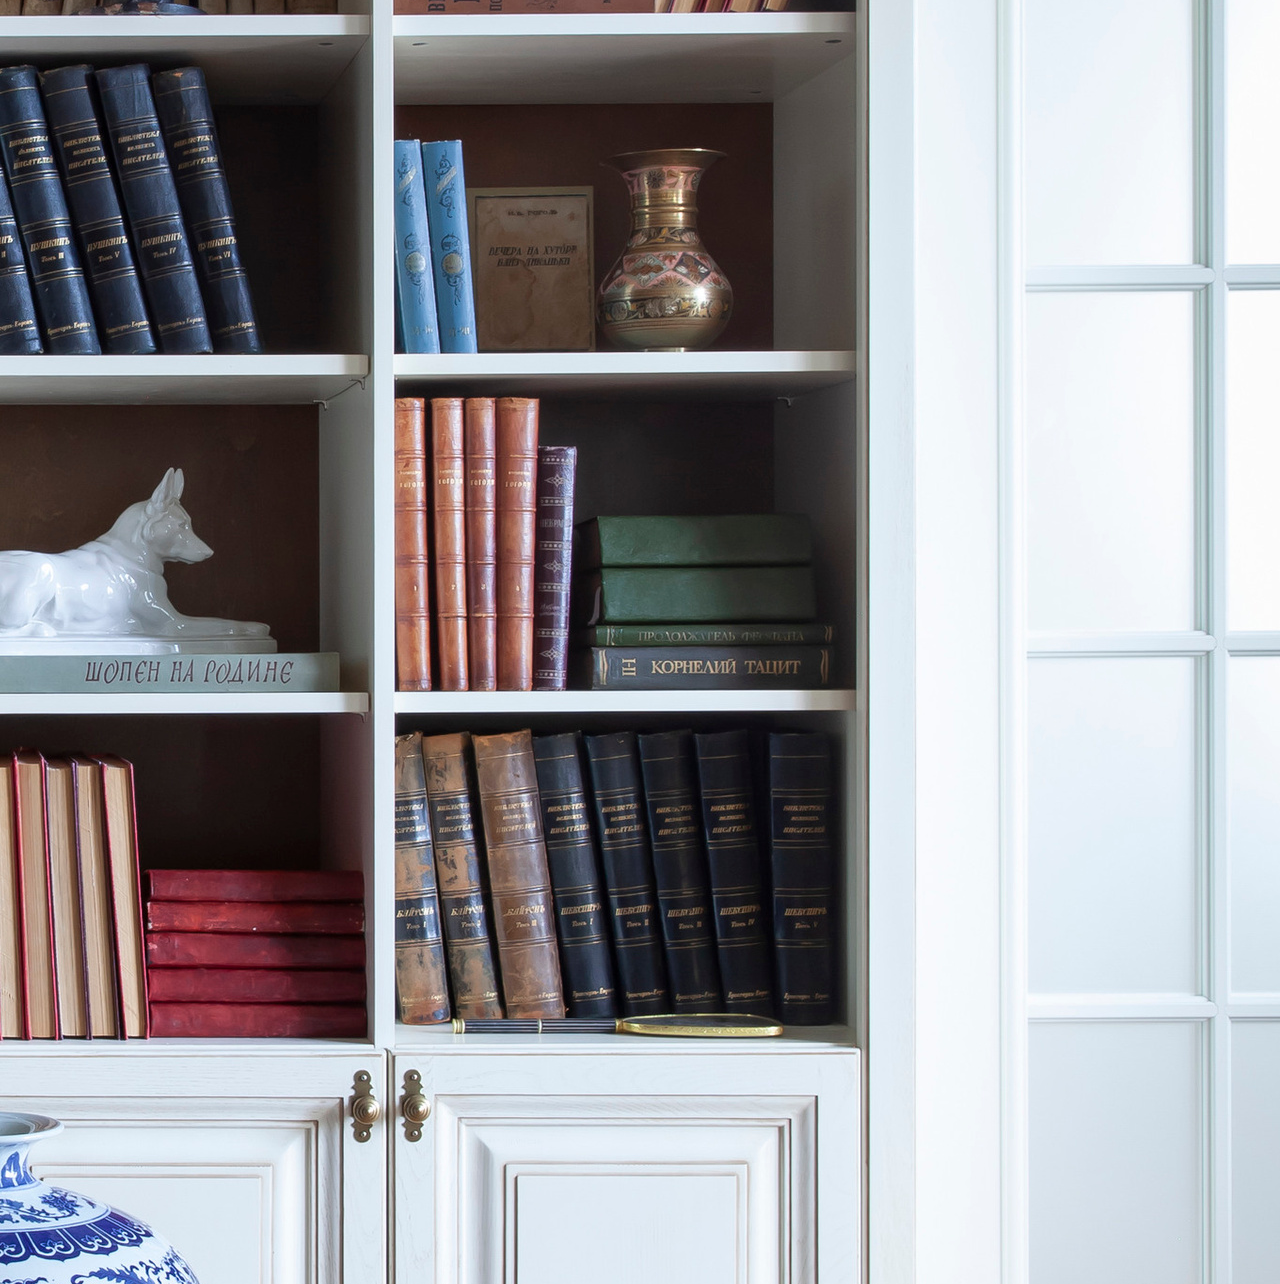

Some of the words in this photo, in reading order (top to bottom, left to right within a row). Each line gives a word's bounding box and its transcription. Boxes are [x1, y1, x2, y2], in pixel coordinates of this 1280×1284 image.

[30, 236, 70, 252] ПУШКИНЪ
[87, 235, 128, 252] ПУШКИНЪ
[141, 232, 183, 248] ПУШКИНЪ
[197, 235, 237, 252] ПУШКИНЪ
[489, 246, 522, 256] ВЕЧЕРА
[527, 246, 539, 256] НА
[637, 630, 736, 643] ПРОДОЛЖАТЕЛЬ
[85, 660, 161, 685] ШОПЕН
[170, 659, 195, 683] НА
[203, 658, 295, 685] РОДИНЕ
[651, 658, 737, 675] КОРНЕЛИЙ
[744, 660, 801, 677] ТАЦИТ
